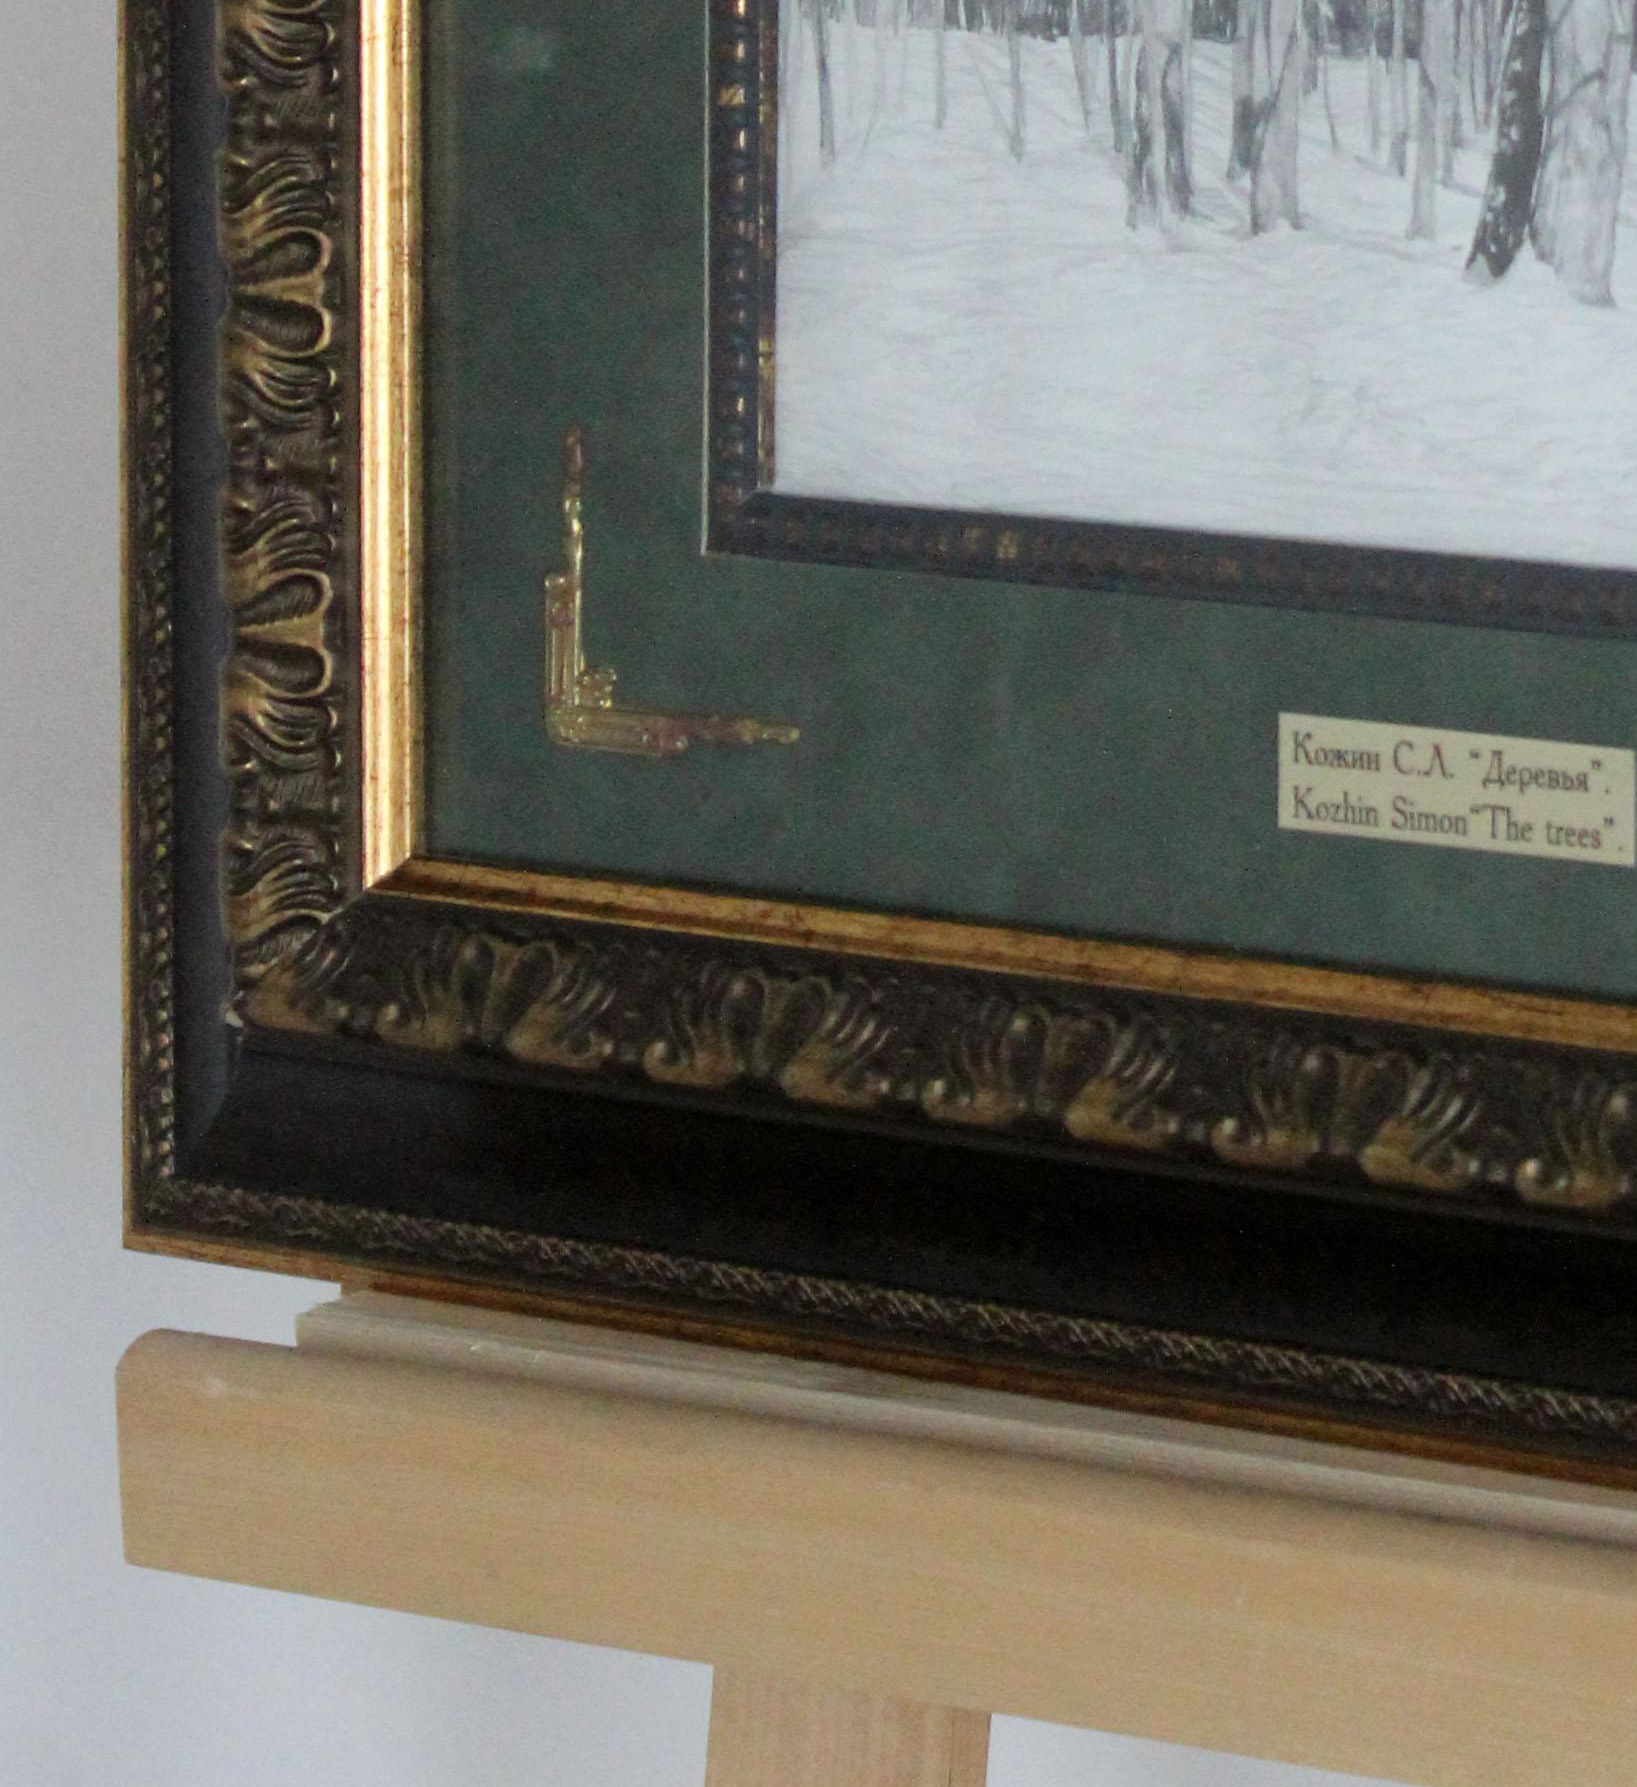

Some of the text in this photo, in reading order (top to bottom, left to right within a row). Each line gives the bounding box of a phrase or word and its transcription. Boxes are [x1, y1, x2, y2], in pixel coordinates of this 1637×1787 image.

[1292, 731, 1382, 773] Кожин
[1292, 785, 1379, 828] Kozhin
[1391, 794, 1469, 837] Simon
